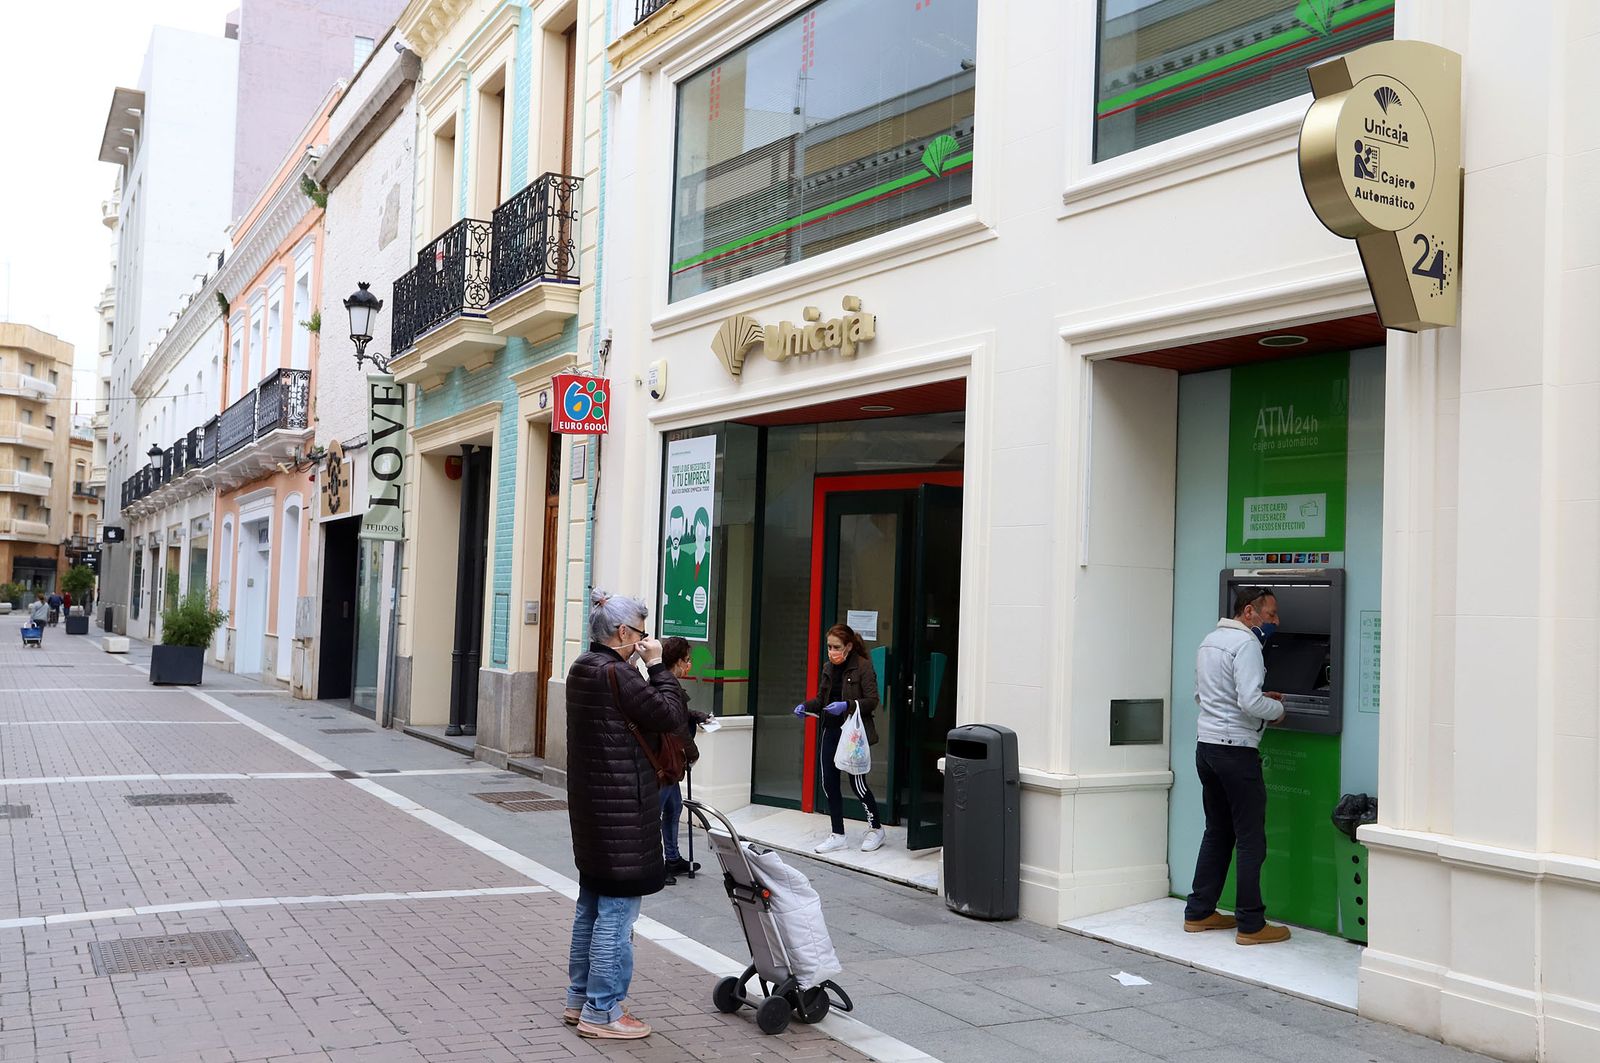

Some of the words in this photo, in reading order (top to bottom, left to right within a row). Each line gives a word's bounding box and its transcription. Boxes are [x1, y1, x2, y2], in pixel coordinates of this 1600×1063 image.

[1364, 117, 1409, 144] Unicaja
[1380, 171, 1416, 190] Cajero
[1354, 186, 1415, 211] Automático
[1411, 233, 1447, 290] 24
[763, 294, 877, 362] Unicaja
[559, 421, 583, 431] EURO
[584, 422, 608, 432] 6000
[368, 382, 405, 510] LOVE
[1253, 440, 1275, 453] cajero
[671, 474, 676, 487] Y
[677, 473, 684, 487] TU
[684, 470, 710, 486] EMPRESA
[365, 523, 399, 533] TEJIDOS
